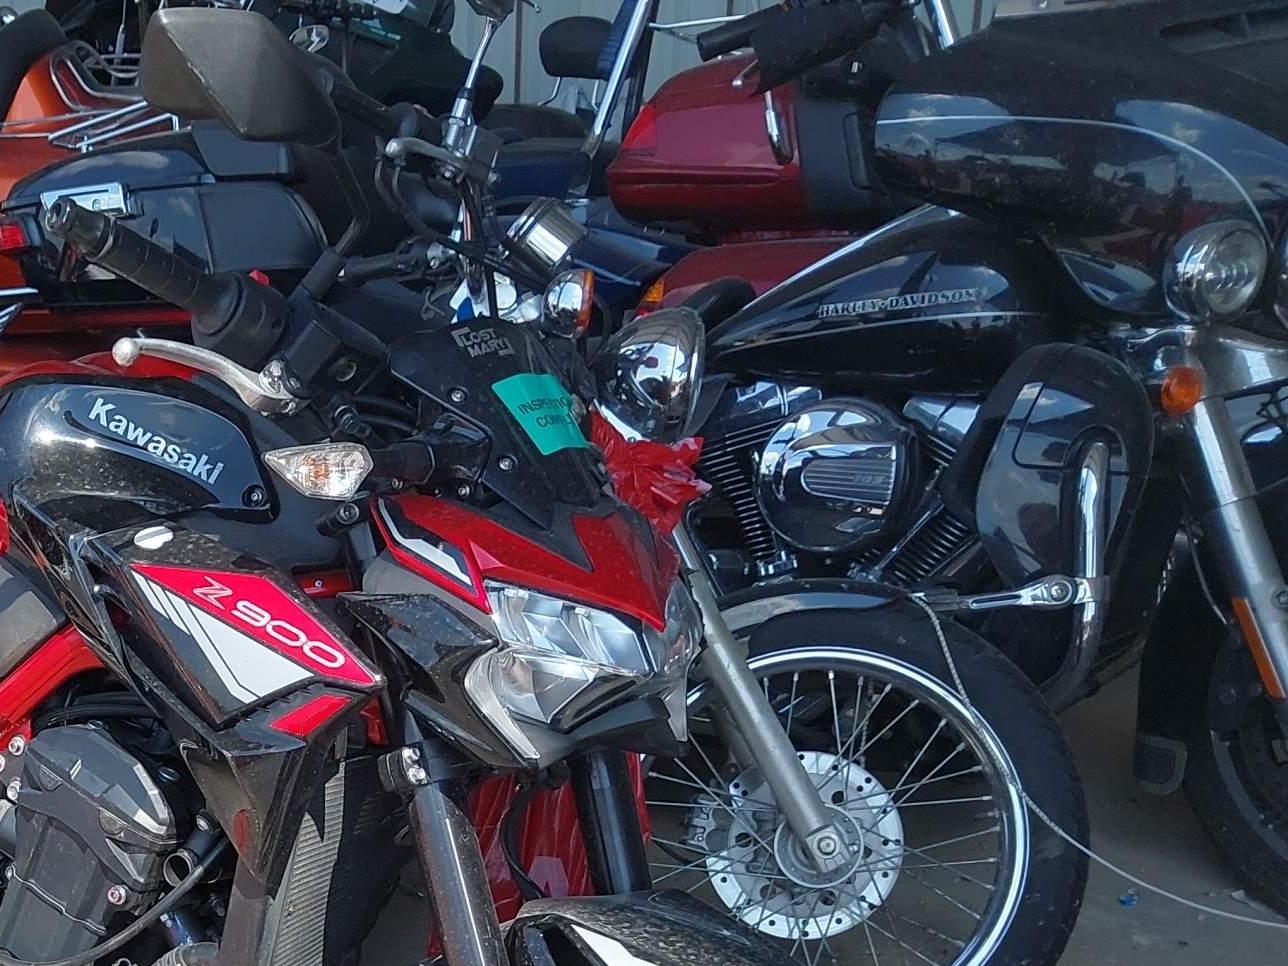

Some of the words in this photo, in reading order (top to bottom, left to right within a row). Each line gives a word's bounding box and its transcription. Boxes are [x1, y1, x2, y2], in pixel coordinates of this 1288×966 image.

[460, 328, 496, 346] LOST
[466, 338, 507, 358] MARY
[88, 397, 224, 484] Kawasaki
